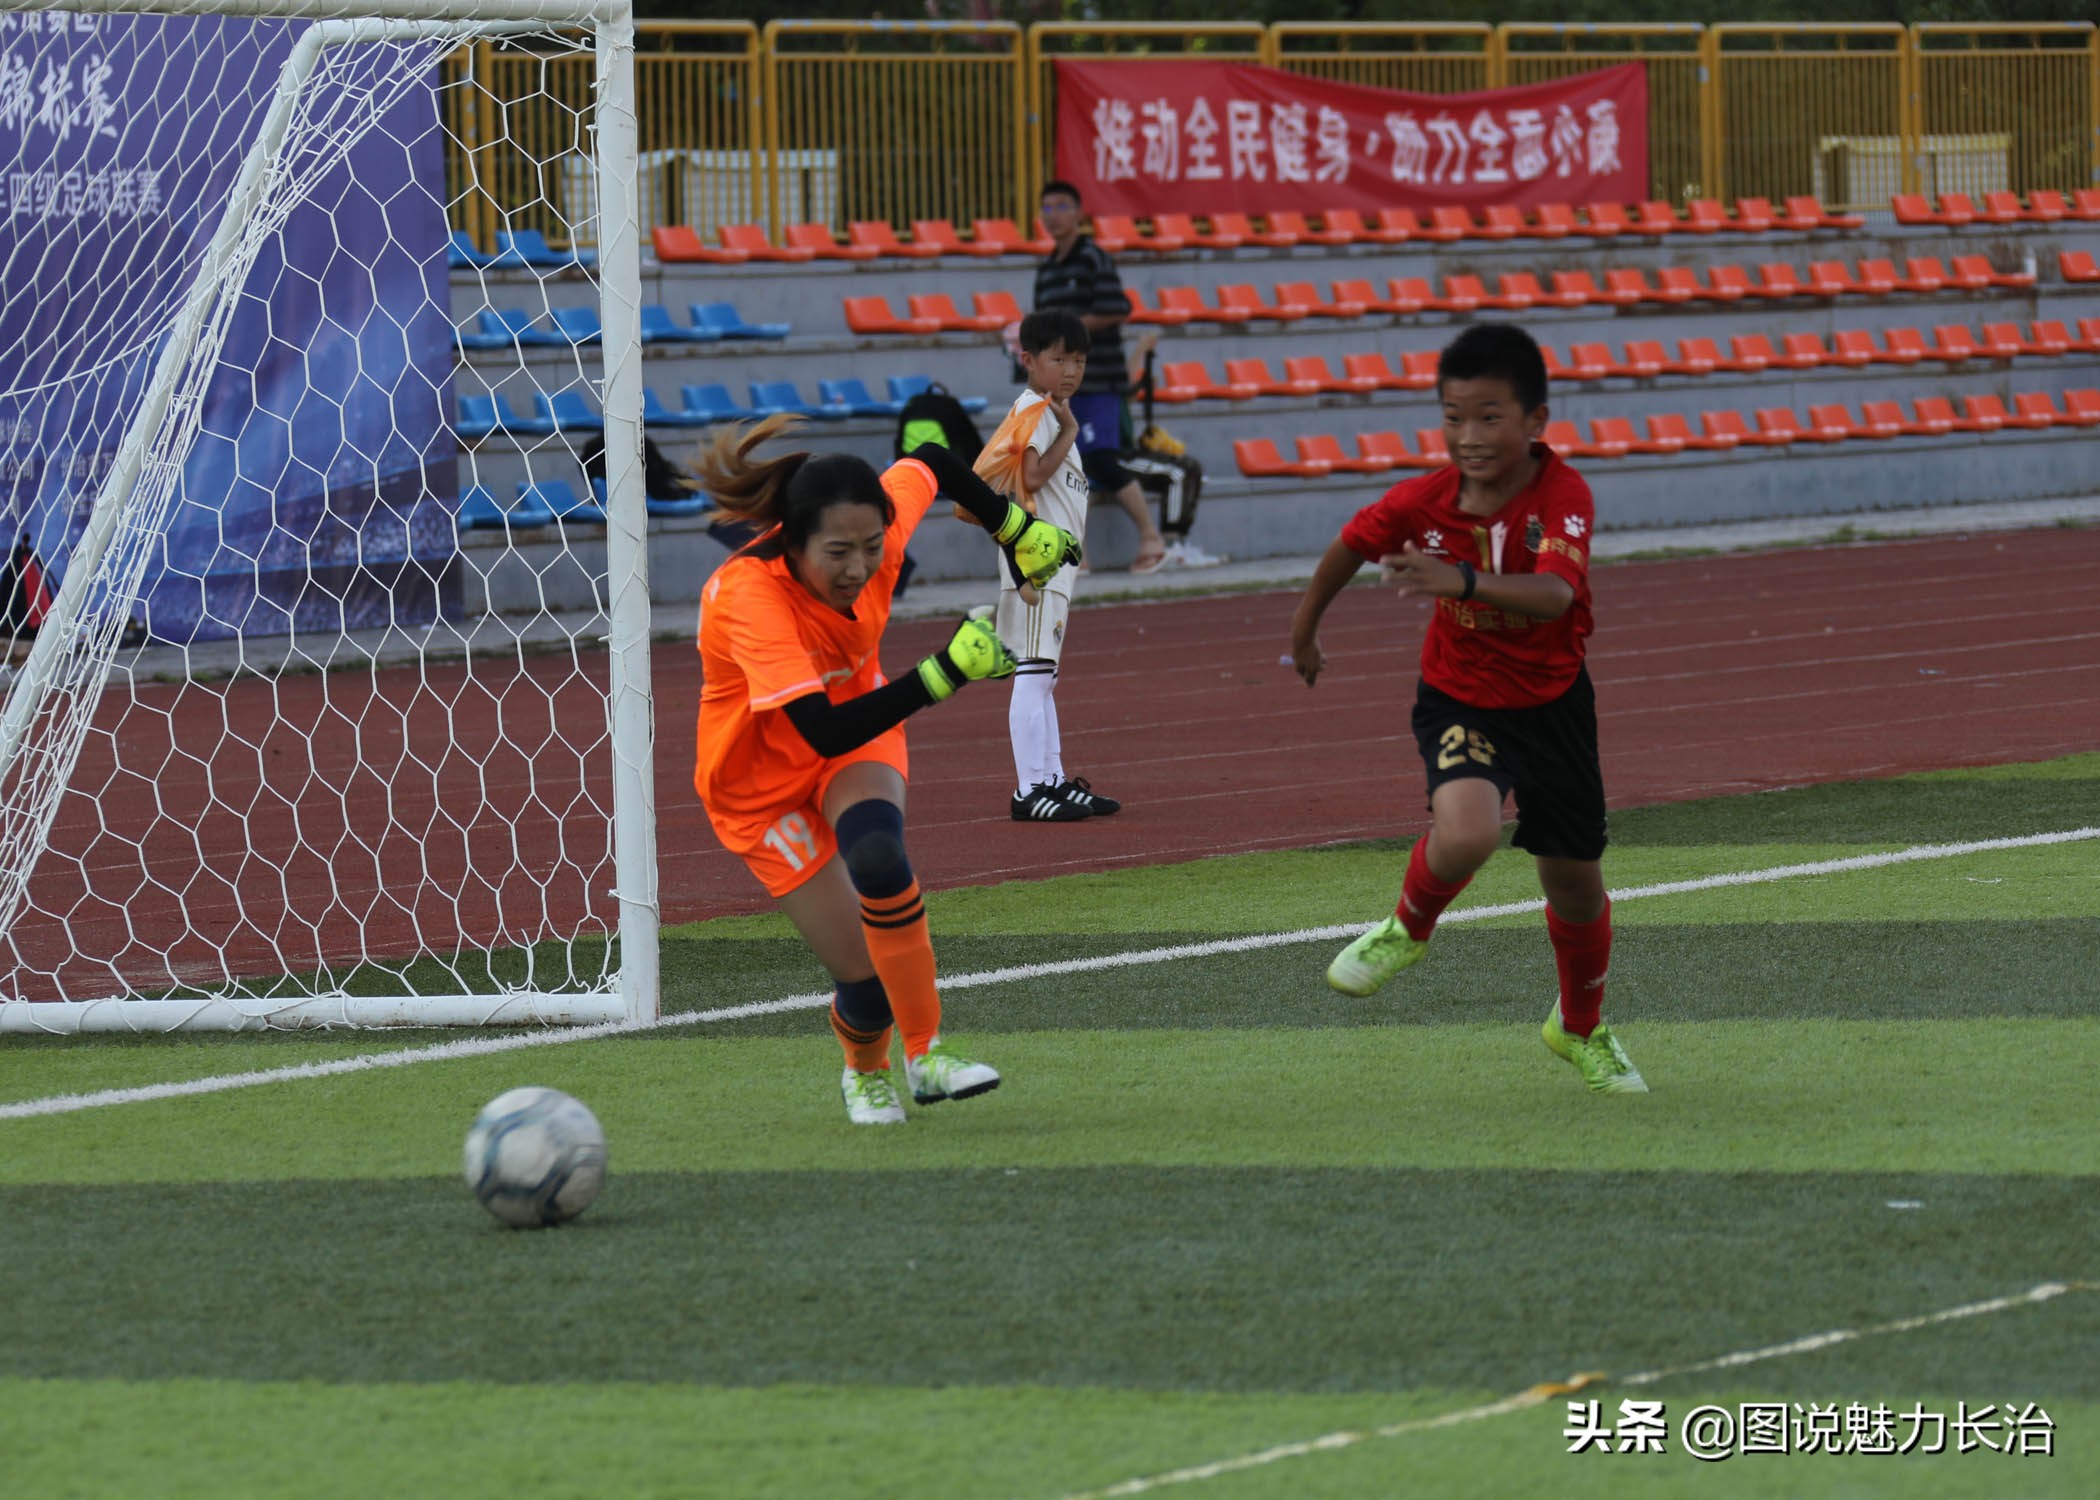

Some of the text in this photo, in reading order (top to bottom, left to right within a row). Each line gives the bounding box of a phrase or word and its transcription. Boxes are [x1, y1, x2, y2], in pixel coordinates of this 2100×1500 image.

[0, 169, 162, 218] 四级足球联赛
[763, 811, 820, 870] 19
